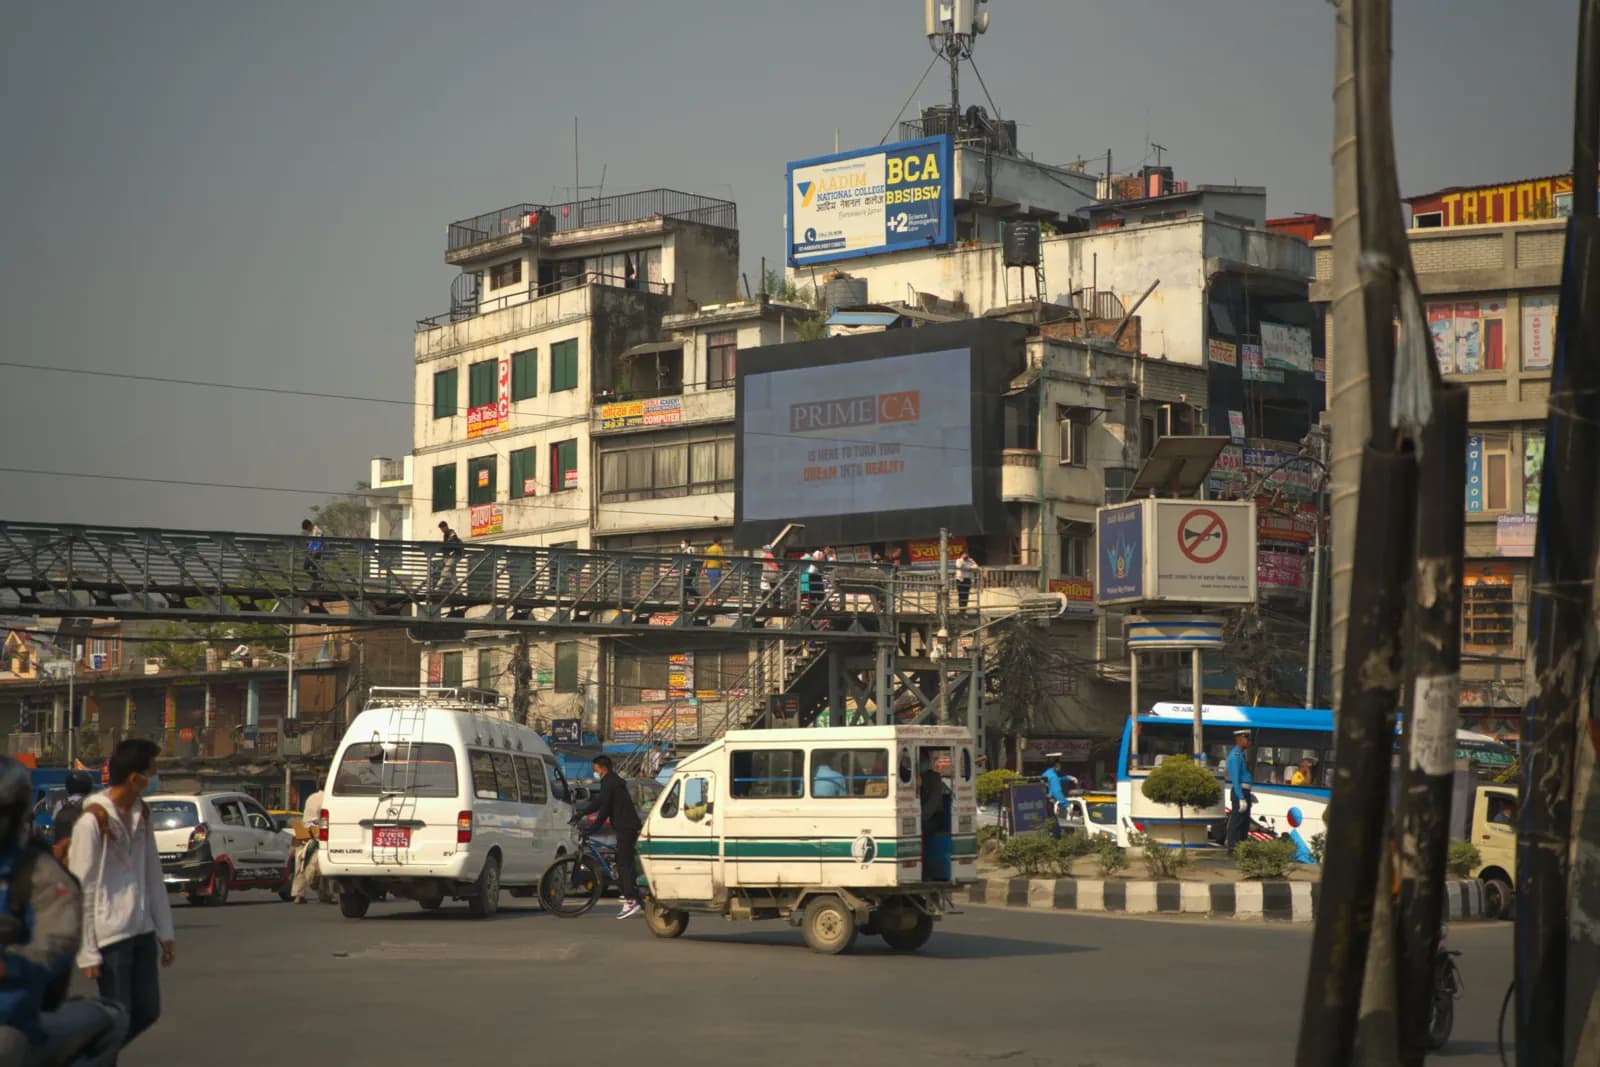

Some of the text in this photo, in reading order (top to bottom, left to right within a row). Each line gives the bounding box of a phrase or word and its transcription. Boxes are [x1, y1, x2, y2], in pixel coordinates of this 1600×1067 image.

[887, 153, 940, 184] BCA
[816, 184, 885, 202] NATIONAL COLLEGE
[887, 212, 909, 232] +2
[644, 412, 680, 425] COMPUTER
[792, 395, 917, 429] PRIME CA
[1213, 455, 1242, 468] APAN
[1469, 437, 1479, 509] Saloon
